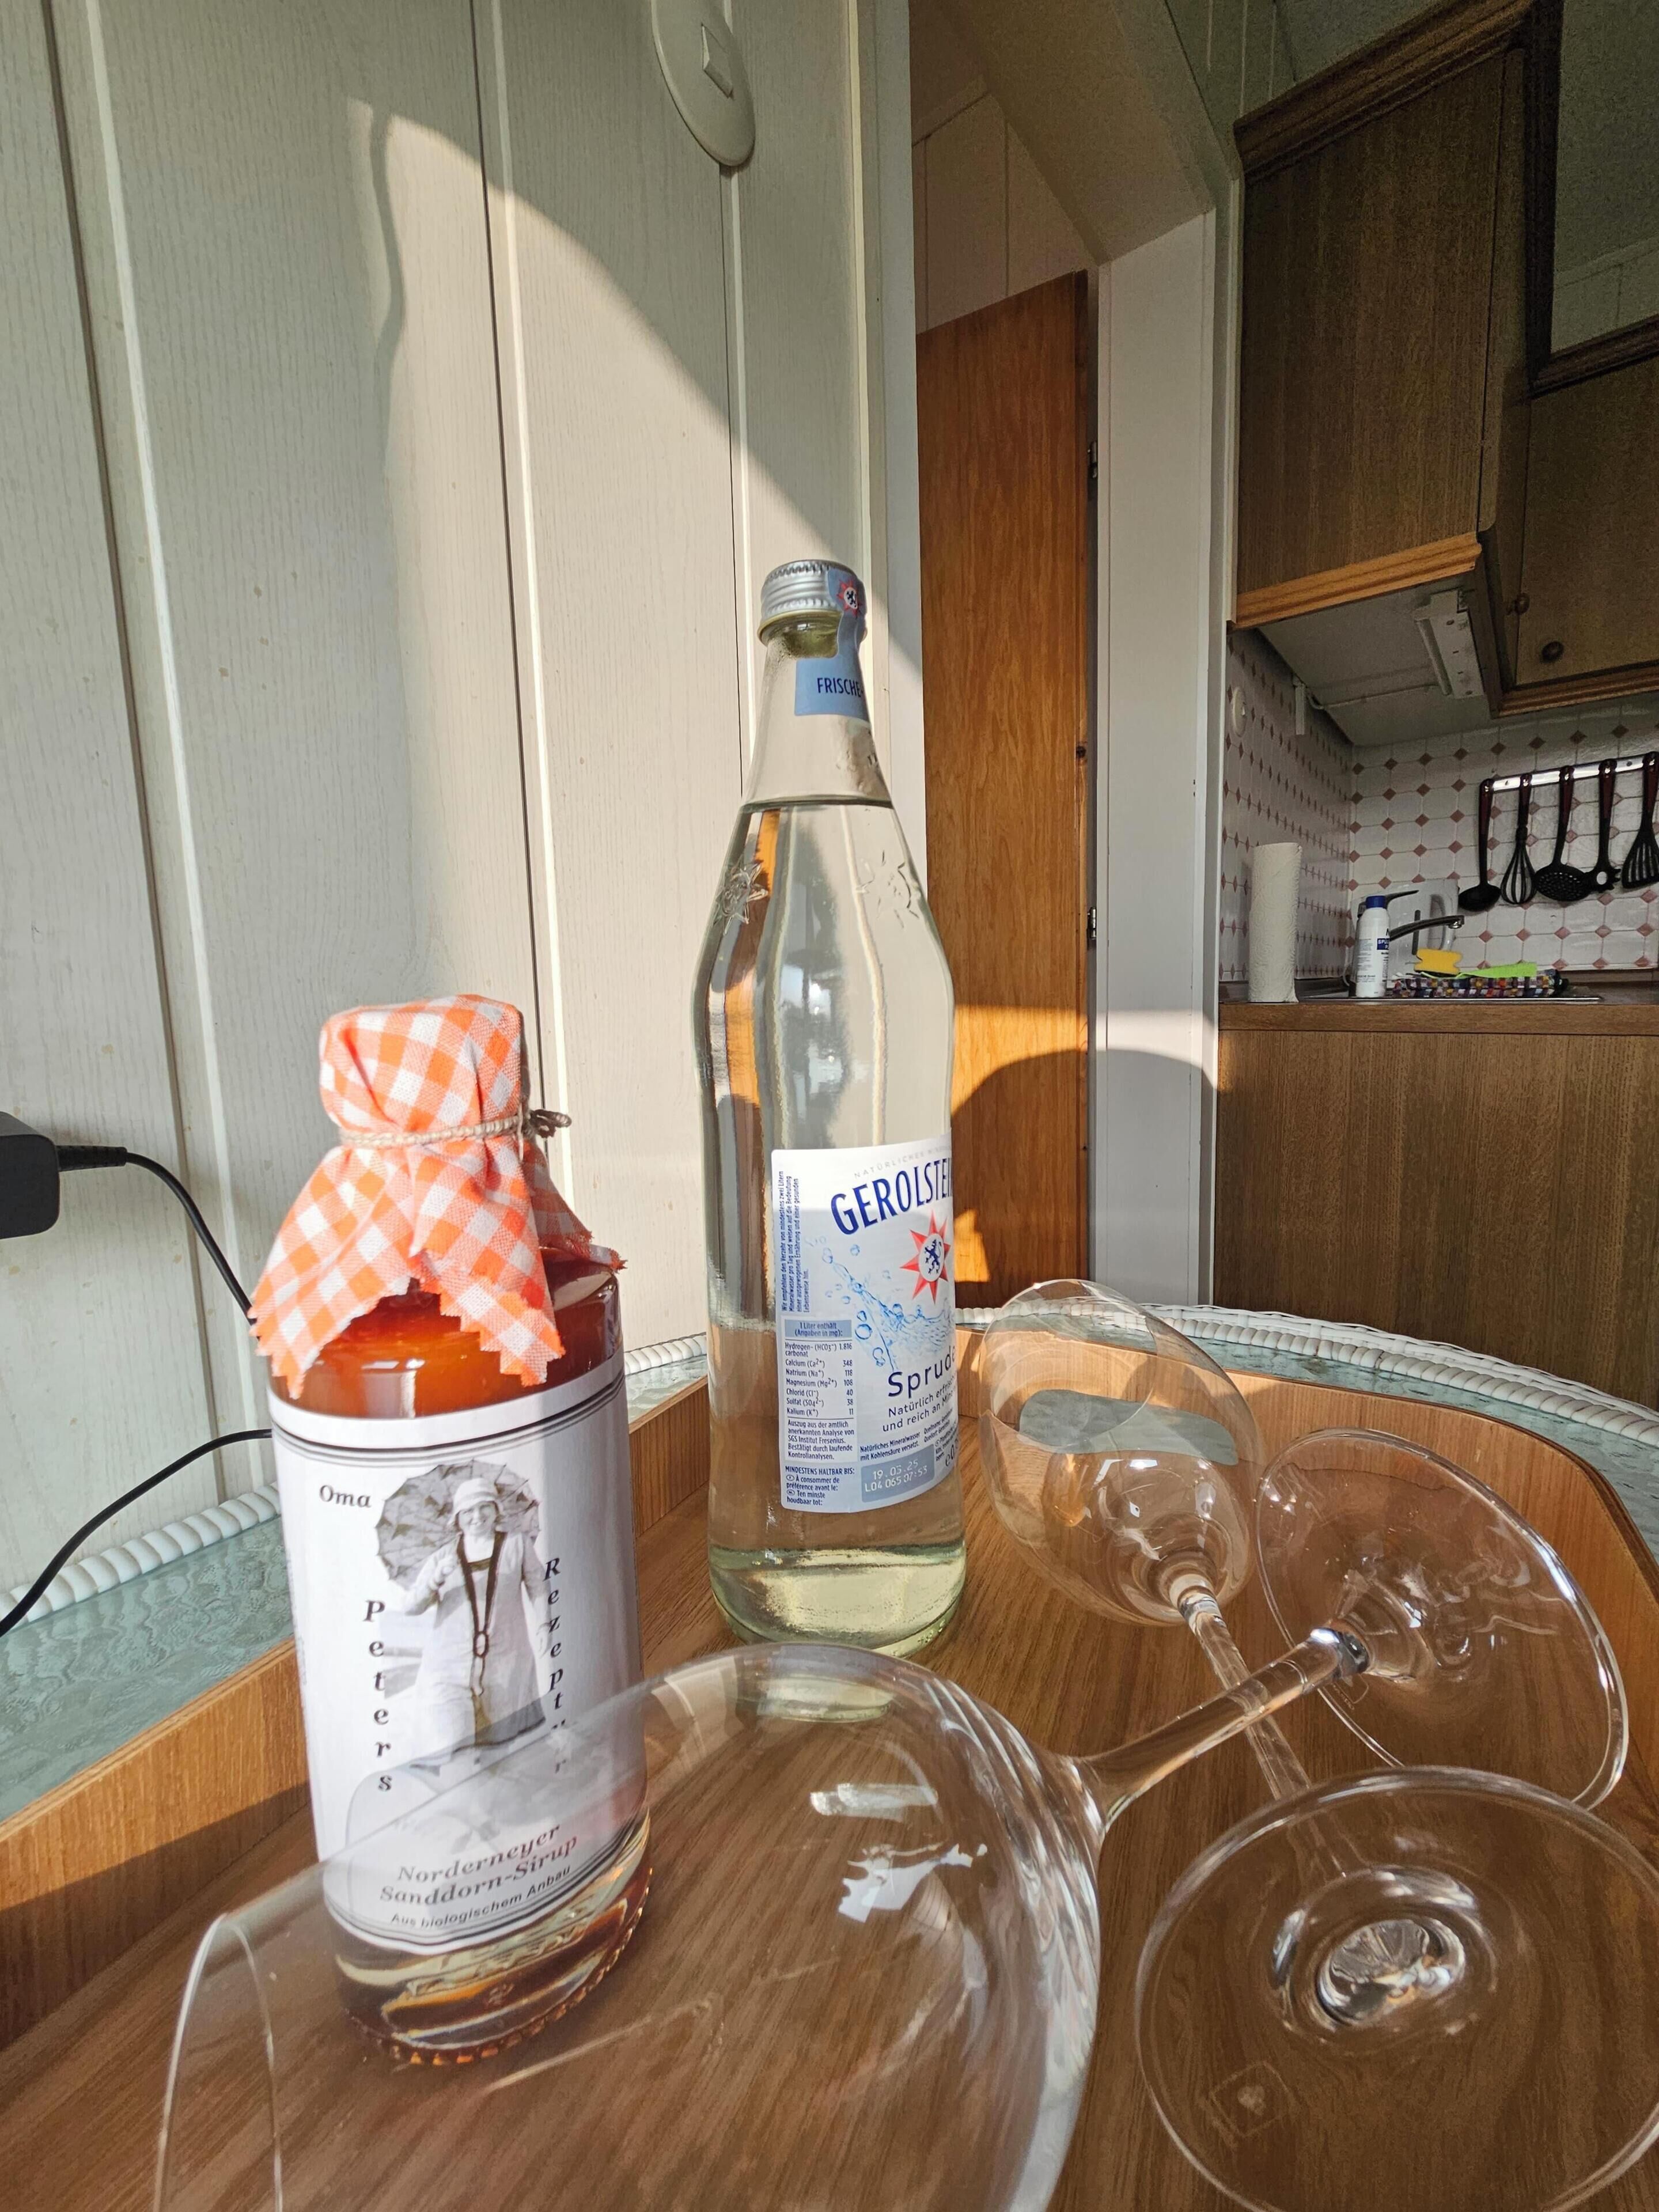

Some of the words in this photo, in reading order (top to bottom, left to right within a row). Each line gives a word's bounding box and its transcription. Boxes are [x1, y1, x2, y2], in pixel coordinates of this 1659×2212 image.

[831, 1157, 952, 1235] GEROLSTEI
[785, 1342, 813, 1351] Hydrogen-
[786, 1359, 806, 1367] Calcium
[786, 1378, 816, 1387] Magnesium
[786, 1388, 805, 1396] Chlorid
[889, 1393, 933, 1417] Natürlich
[788, 1419, 806, 1427] Auszug
[882, 1418, 903, 1432] und
[907, 1409, 929, 1425] reich
[932, 1403, 940, 1413] an
[788, 1443, 811, 1451] Bestätigt
[860, 1442, 889, 1453] Natürliches
[889, 1432, 921, 1446] Mineralwasser
[788, 1451, 834, 1460] Kontrollanalysen.
[860, 1453, 869, 1461] mit
[870, 1447, 900, 1459] Kohlensäure
[902, 1441, 920, 1452] versetzt.
[785, 1465, 817, 1475] MINDESTENS
[786, 1482, 813, 1491] préférence
[885, 1476, 902, 1488] 065
[319, 1484, 372, 1508] Oma
[787, 1496, 811, 1505] houdbaar
[543, 1557, 566, 1774] Rezeptr
[363, 1599, 393, 1791] Peters
[397, 1824, 560, 1883] Norderneyer
[380, 1835, 577, 1906] Sanddorn-Sirup
[391, 1913, 416, 1927] Aus
[421, 1893, 521, 1928] biologischem
[527, 1865, 570, 1899] Anbau
